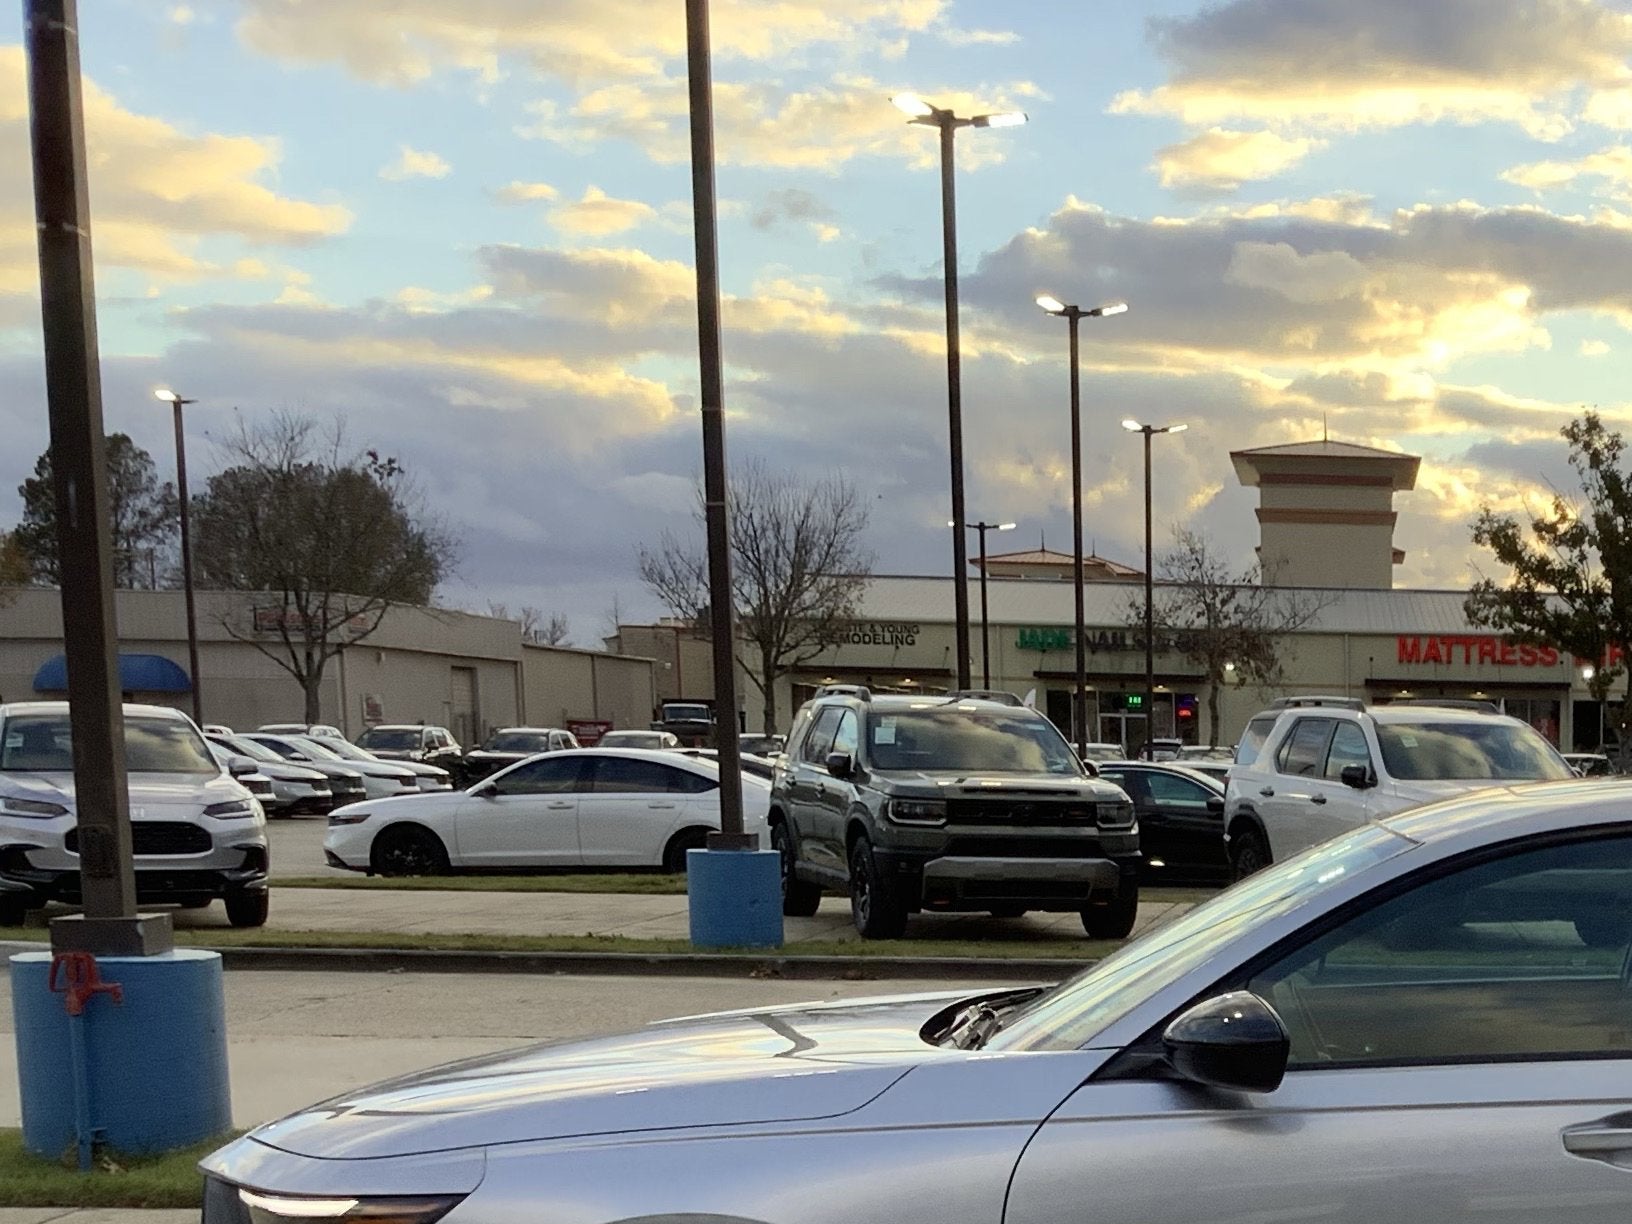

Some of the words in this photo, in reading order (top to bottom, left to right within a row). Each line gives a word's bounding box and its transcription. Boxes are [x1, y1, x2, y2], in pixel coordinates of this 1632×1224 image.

[880, 624, 920, 635] YOUNG
[820, 632, 917, 646] EMODELING
[1396, 634, 1559, 668] MATTRESS
